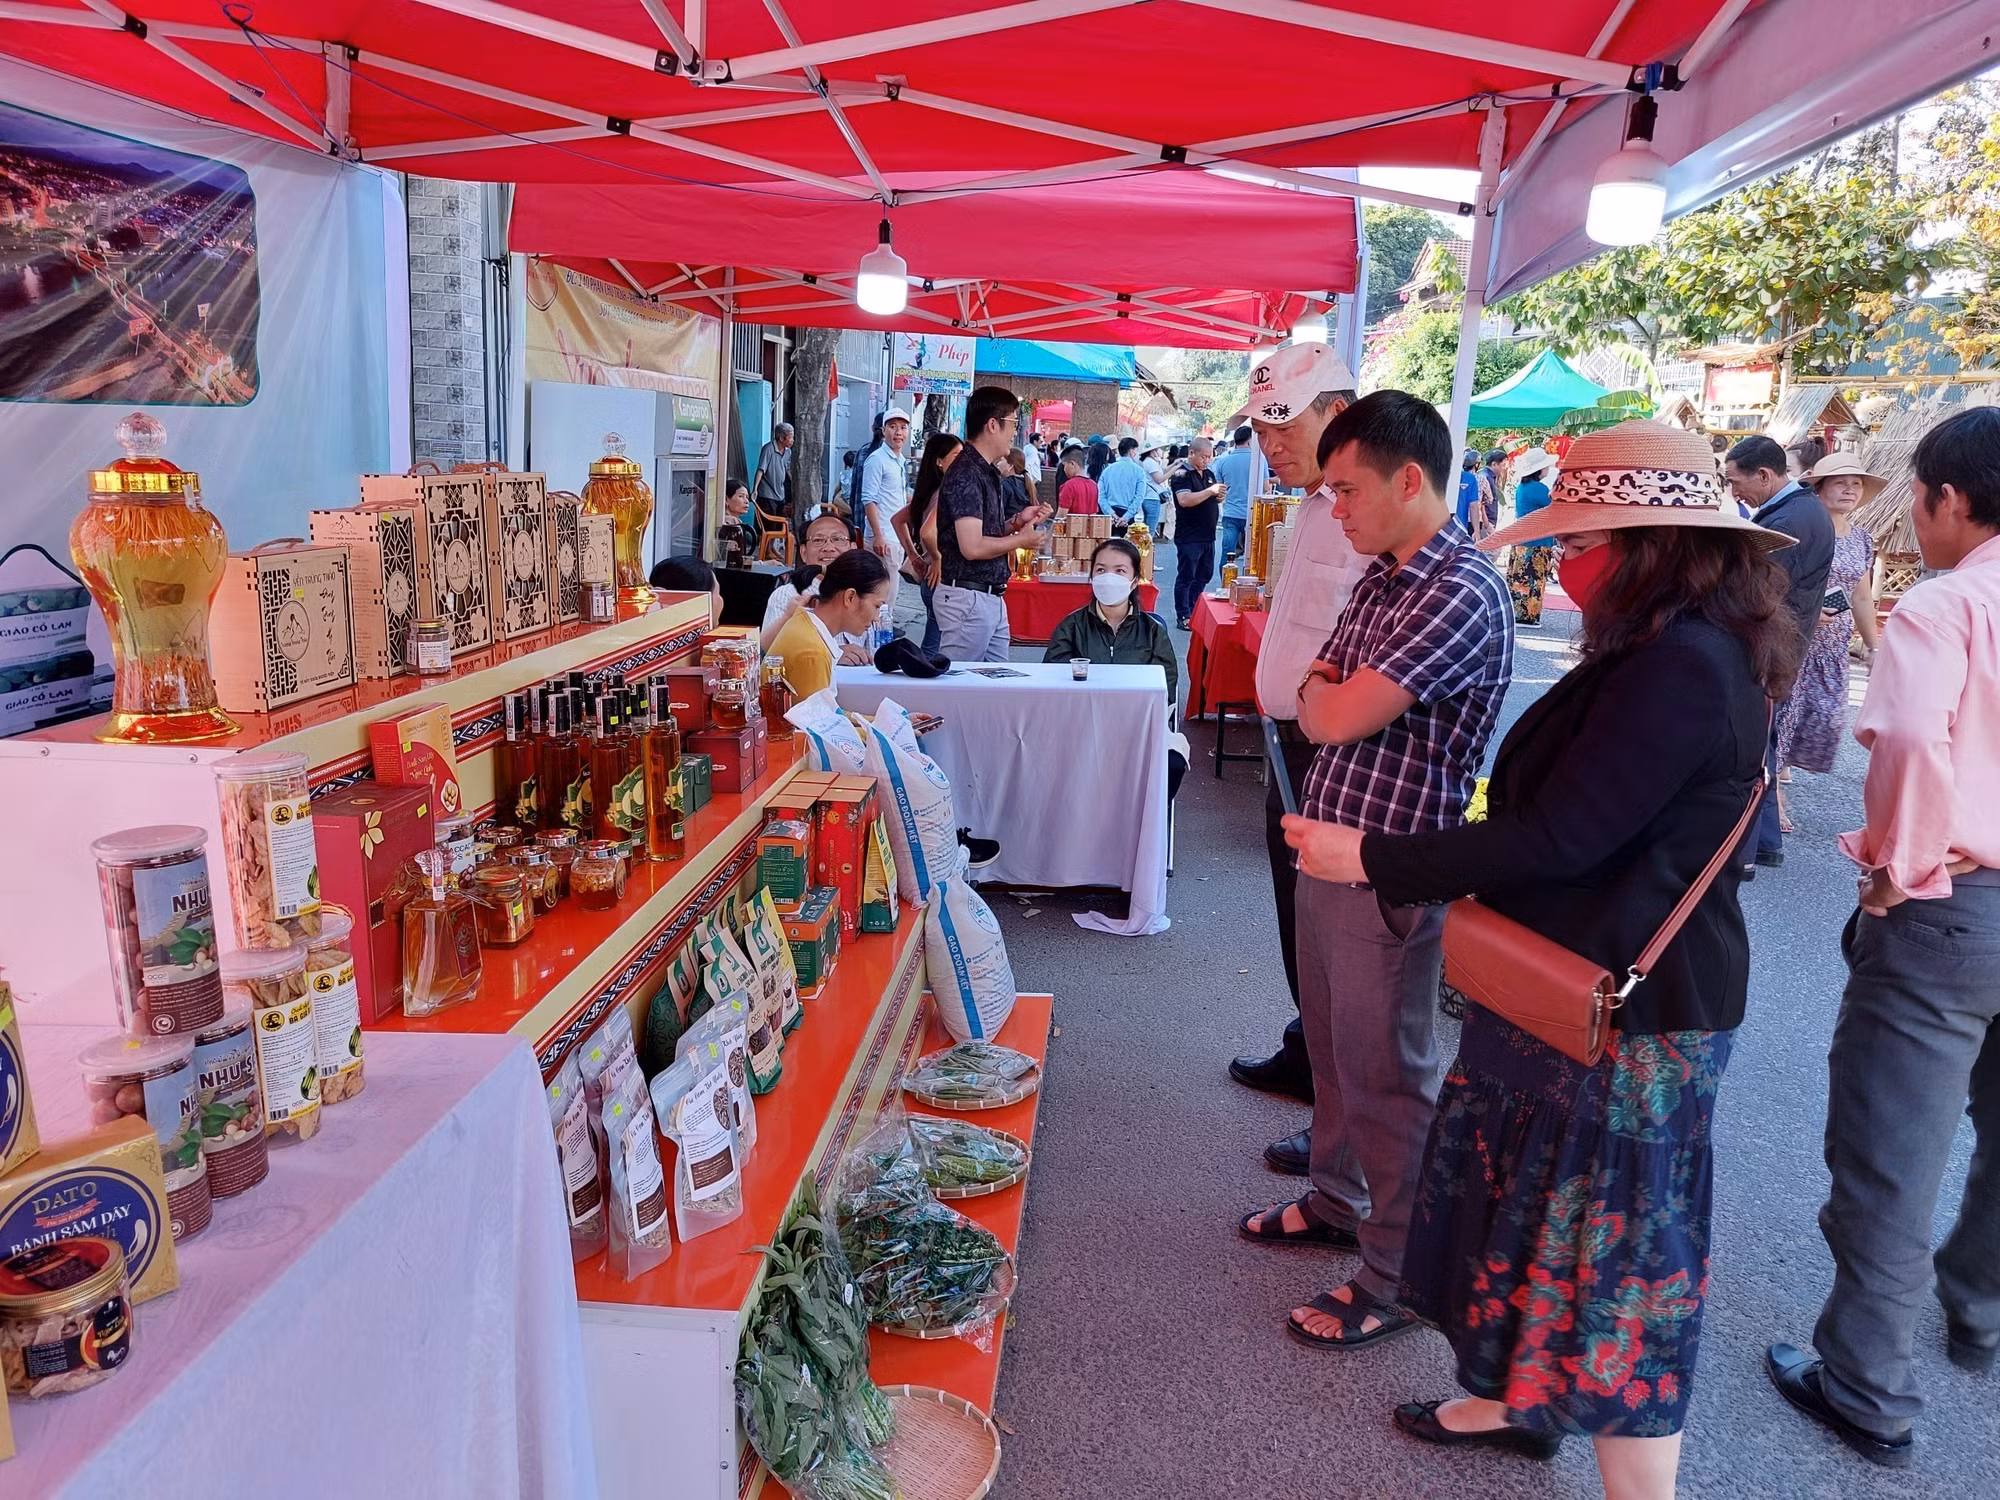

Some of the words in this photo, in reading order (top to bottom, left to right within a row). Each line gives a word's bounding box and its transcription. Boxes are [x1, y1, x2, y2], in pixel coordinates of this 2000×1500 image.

[1251, 383, 1275, 395] CHANEL
[678, 397, 709, 422] Kangaroo
[51, 620, 72, 631] LAM
[49, 689, 73, 700] LAM
[198, 1061, 242, 1091] NHU
[32, 1181, 97, 1216] DATO
[11, 1230, 57, 1256] BÁNH
[60, 1216, 97, 1239] SÂM
[100, 1204, 132, 1225] DÂY
